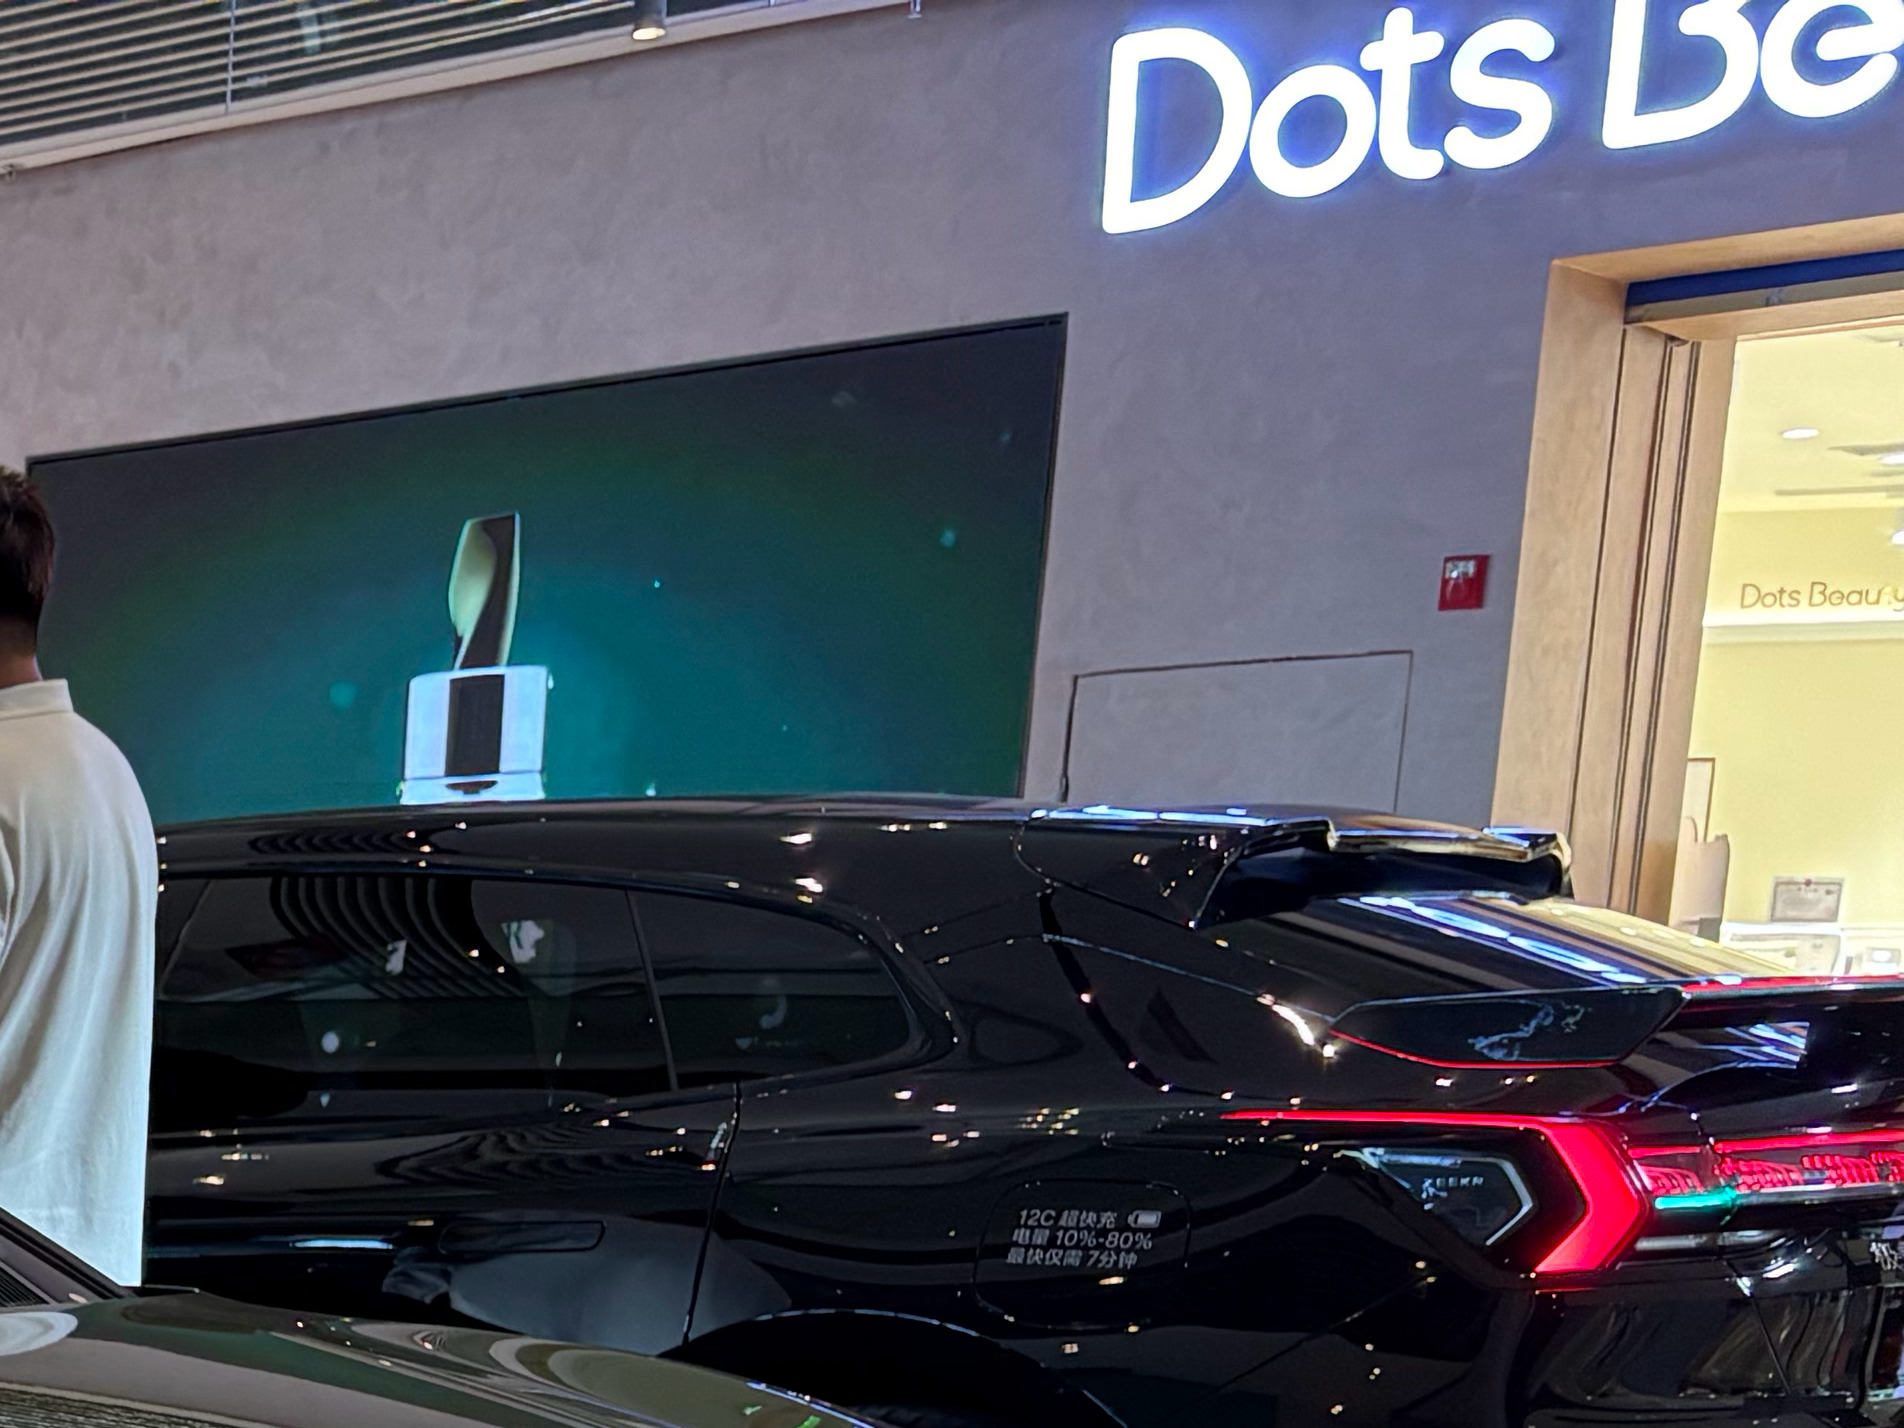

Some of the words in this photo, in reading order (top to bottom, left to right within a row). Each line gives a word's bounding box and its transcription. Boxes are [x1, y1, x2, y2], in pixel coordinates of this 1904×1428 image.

[1101, 5, 1555, 235] Dots
[1740, 583, 1801, 609] Dots
[1020, 1209, 1056, 1227] 12C
[1058, 1209, 1117, 1228] 超快充
[1012, 1228, 1050, 1246] 电量
[1055, 1229, 1152, 1250] 10%-80%
